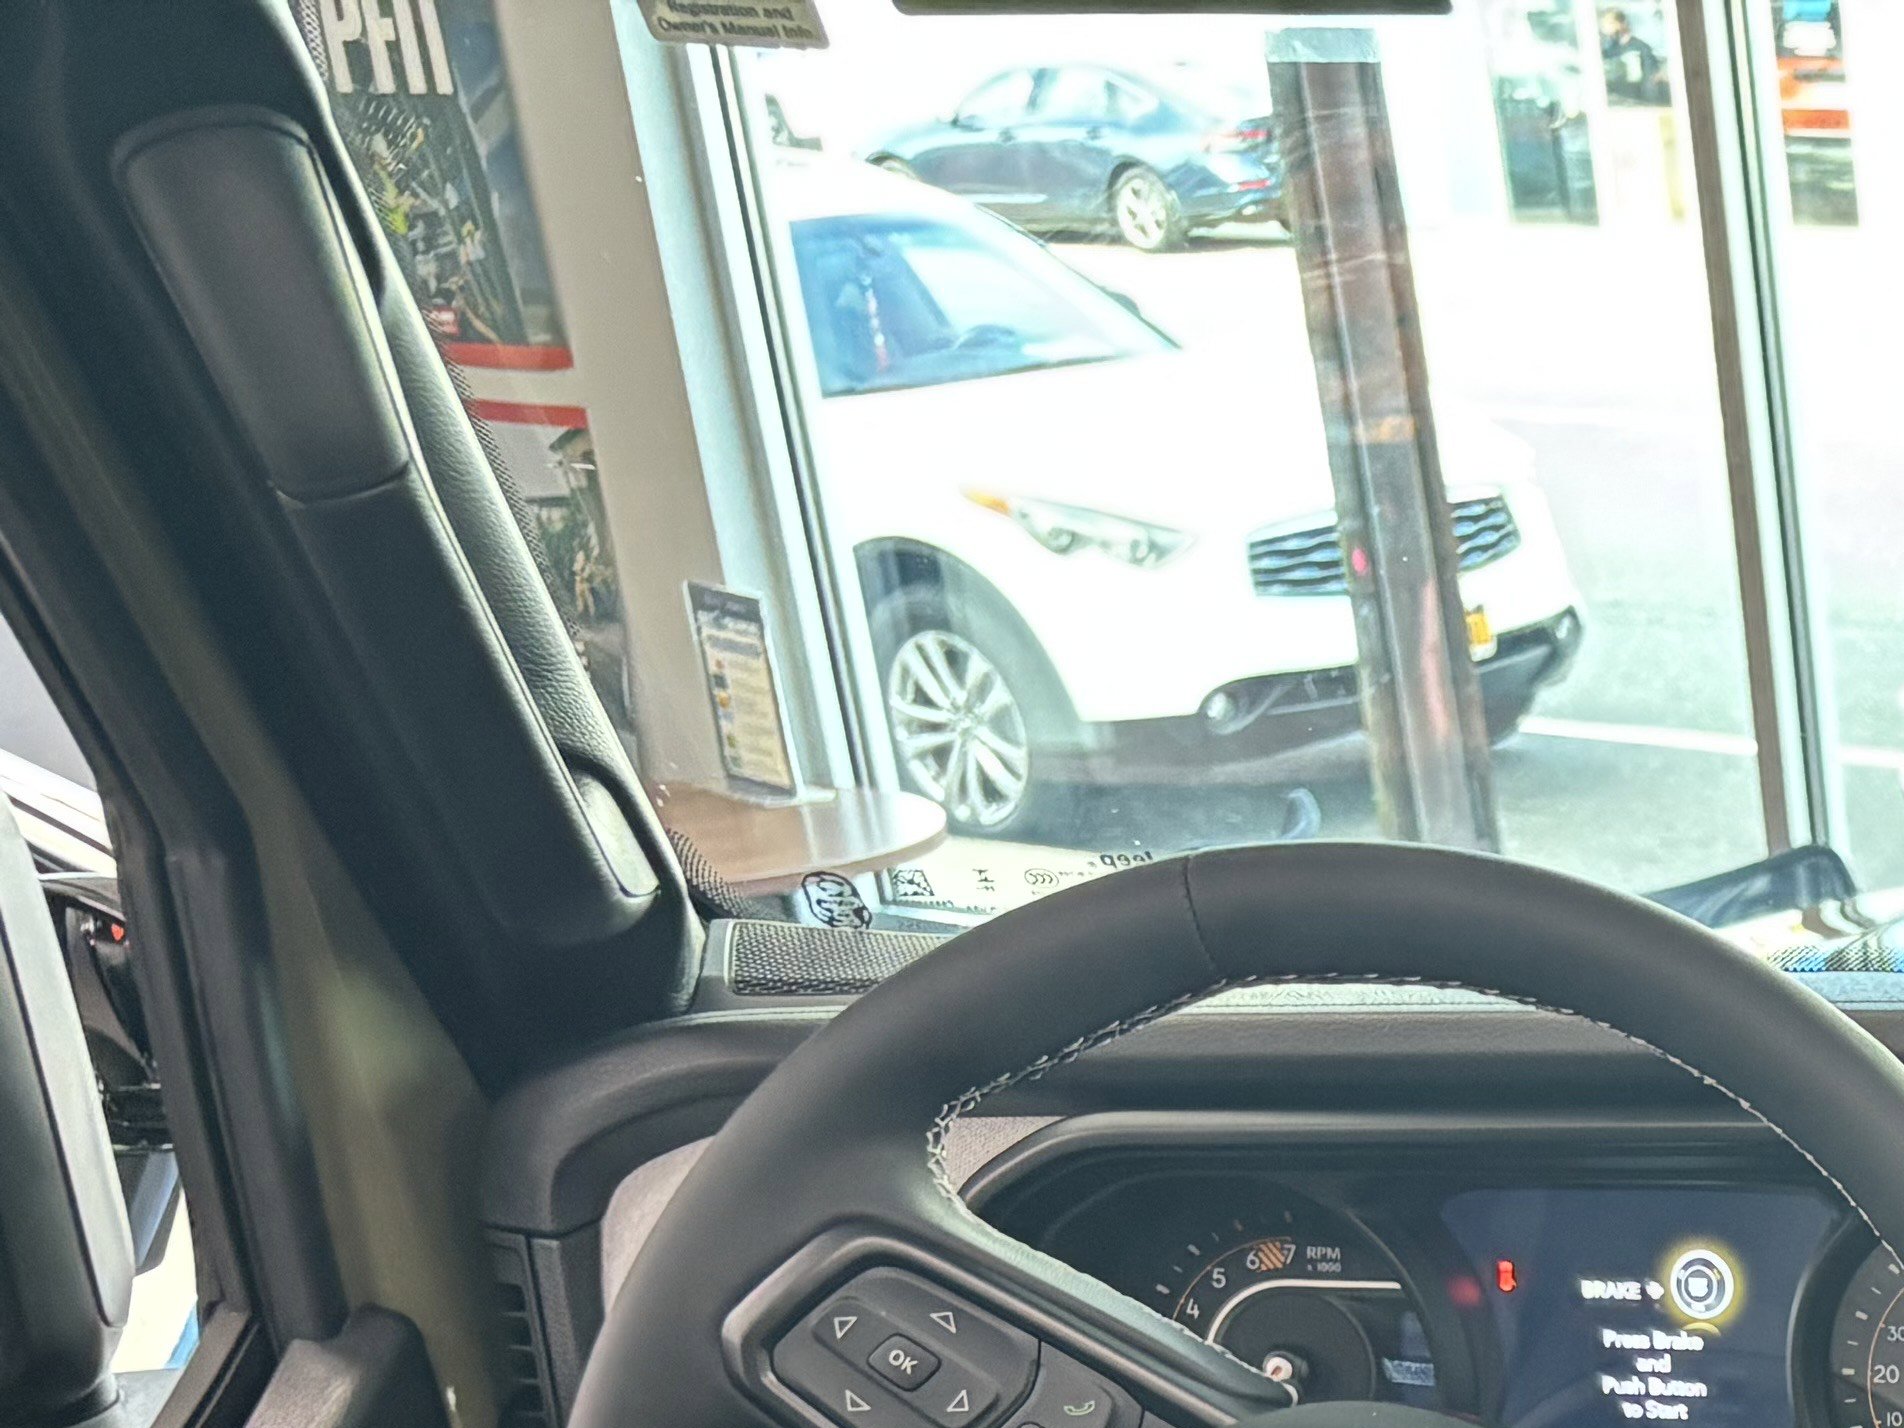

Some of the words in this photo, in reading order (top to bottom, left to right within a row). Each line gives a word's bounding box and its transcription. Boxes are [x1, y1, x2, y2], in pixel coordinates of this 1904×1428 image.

[1246, 1247, 1260, 1270] 6
[1307, 1246, 1342, 1262] RPM
[1210, 1267, 1227, 1290] 5
[1580, 1280, 1643, 1301] BRAKE
[1185, 1298, 1200, 1320] 4
[1601, 1328, 1651, 1350] Press
[1652, 1329, 1705, 1351] Brake
[887, 1348, 919, 1377] OK
[1635, 1353, 1672, 1374] and
[1872, 1364, 1900, 1385] 20
[1601, 1375, 1646, 1396] Push
[1647, 1376, 1708, 1397] Button
[1621, 1401, 1645, 1419] to
[1645, 1399, 1689, 1420] Start
[1886, 1413, 1904, 1427] 10
